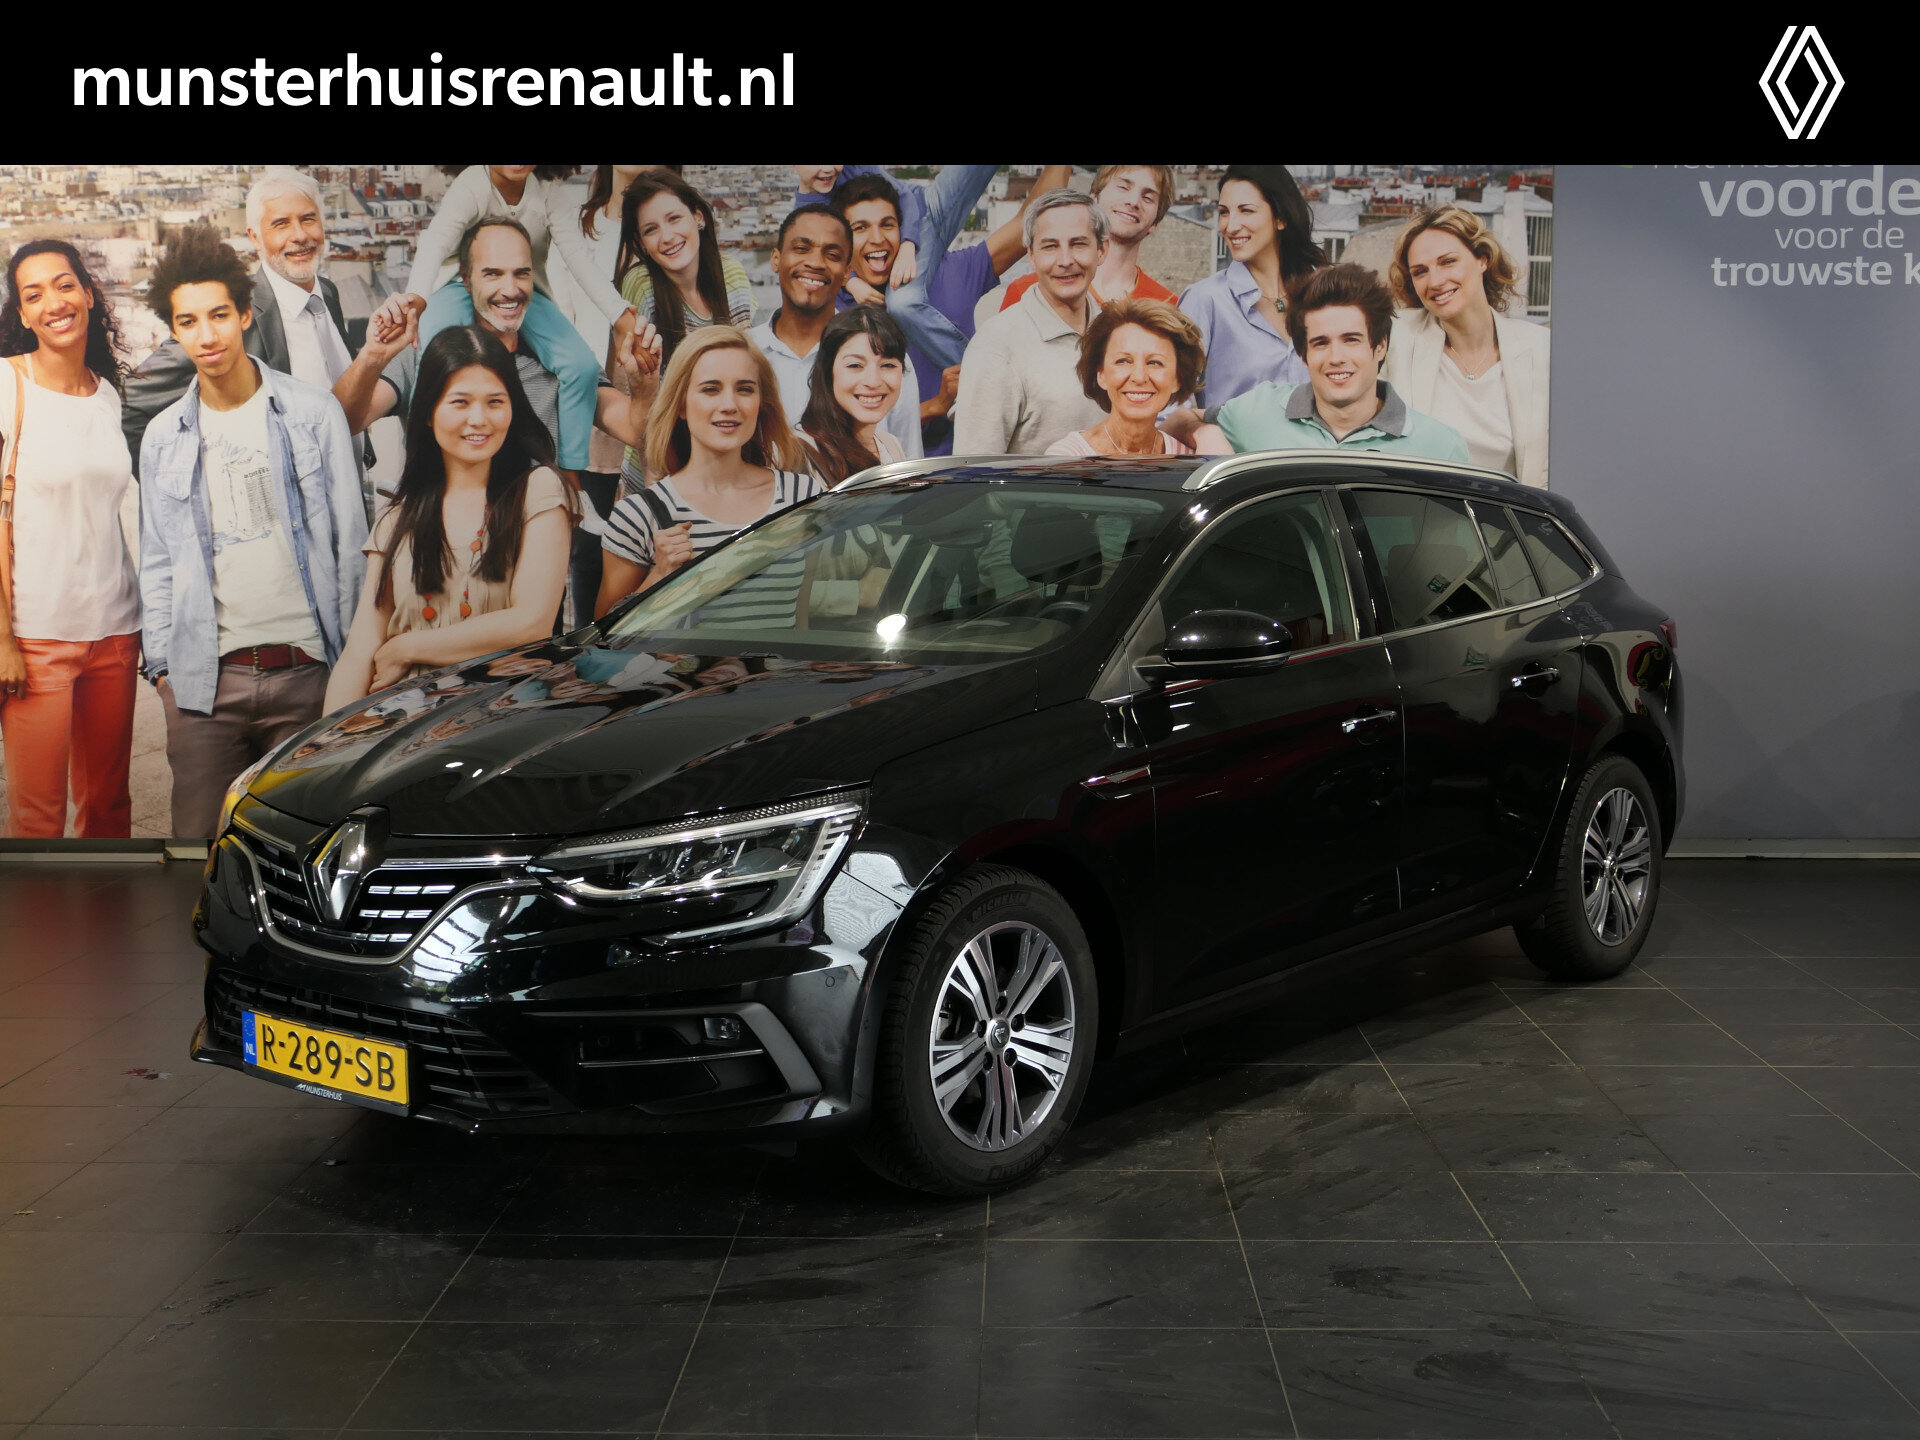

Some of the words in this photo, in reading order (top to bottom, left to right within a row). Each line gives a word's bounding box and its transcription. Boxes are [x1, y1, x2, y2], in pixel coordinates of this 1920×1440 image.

[1775, 227, 1853, 249] voor
[1862, 219, 1905, 248] de
[1711, 256, 1892, 286] trouwste
[245, 1042, 256, 1056] NL
[262, 1023, 395, 1092] R-289-SB
